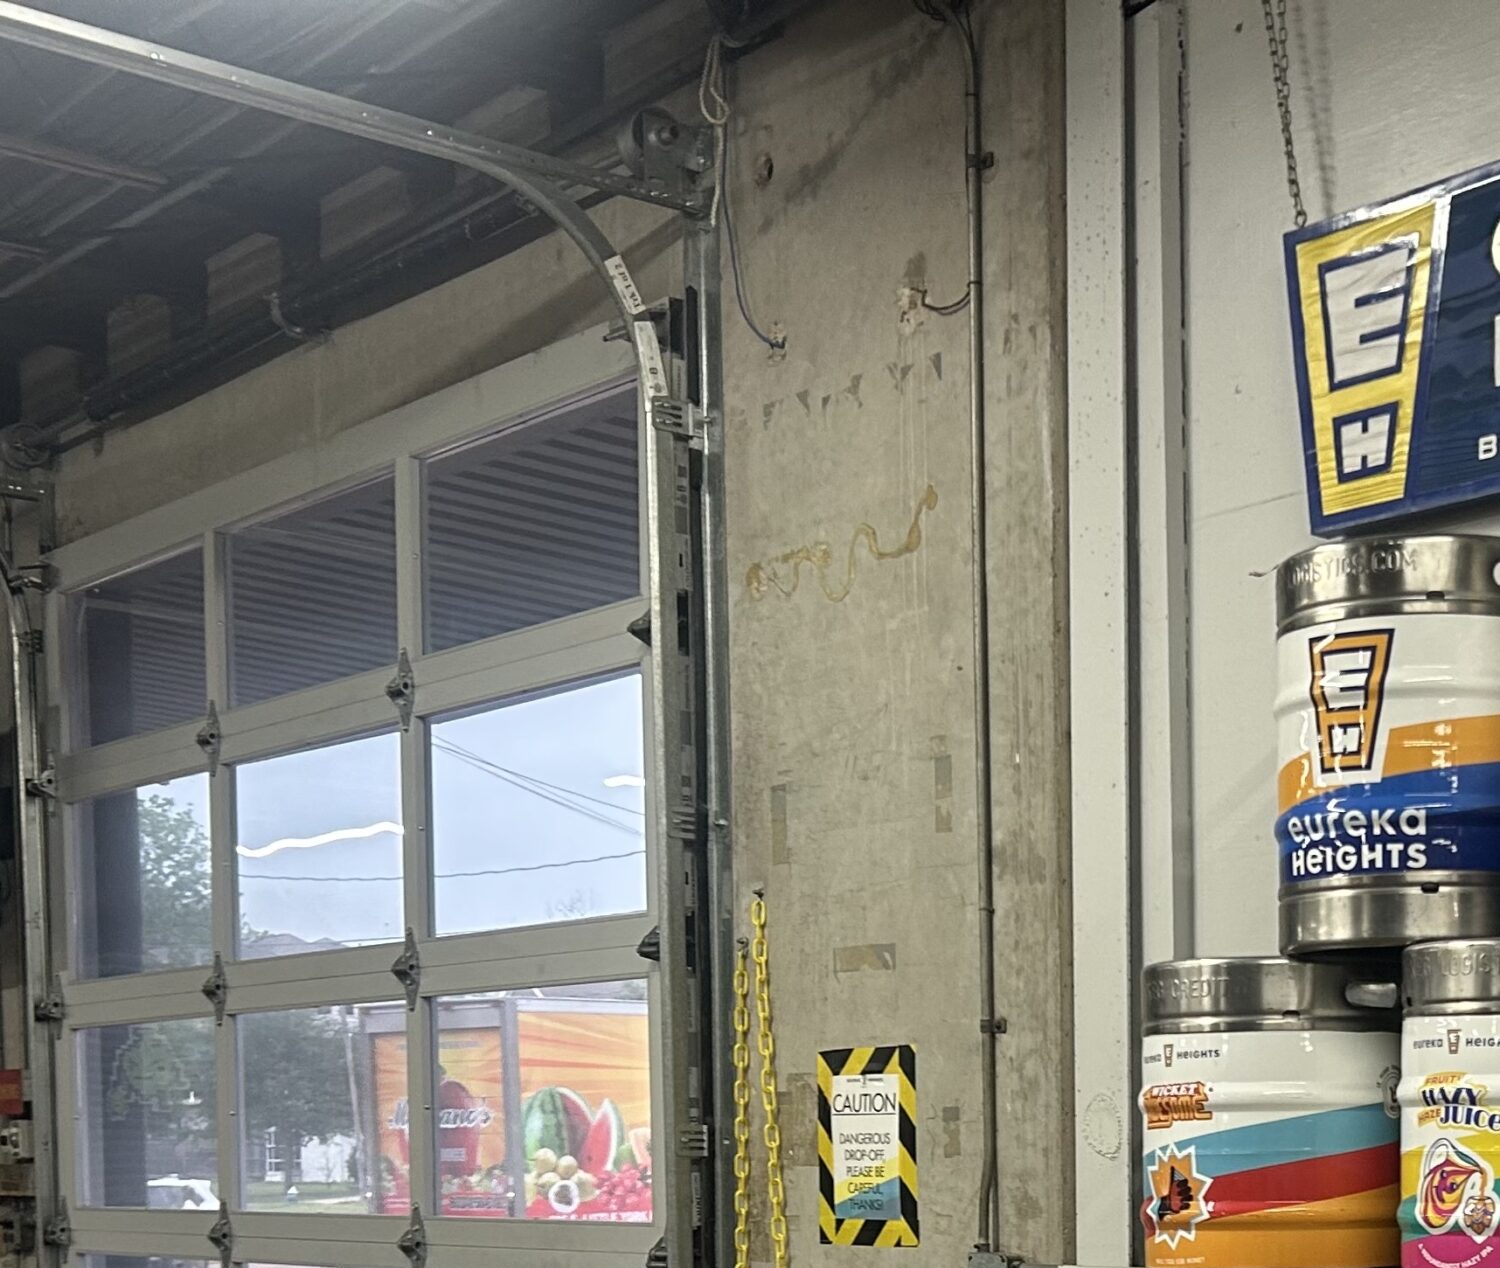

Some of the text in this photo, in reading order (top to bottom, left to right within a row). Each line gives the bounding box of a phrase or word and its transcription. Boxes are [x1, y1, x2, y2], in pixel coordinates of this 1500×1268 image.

[1288, 807, 1428, 844] eureka
[833, 1093, 896, 1113] CAUTION
[838, 1132, 891, 1145] DANGEROUS
